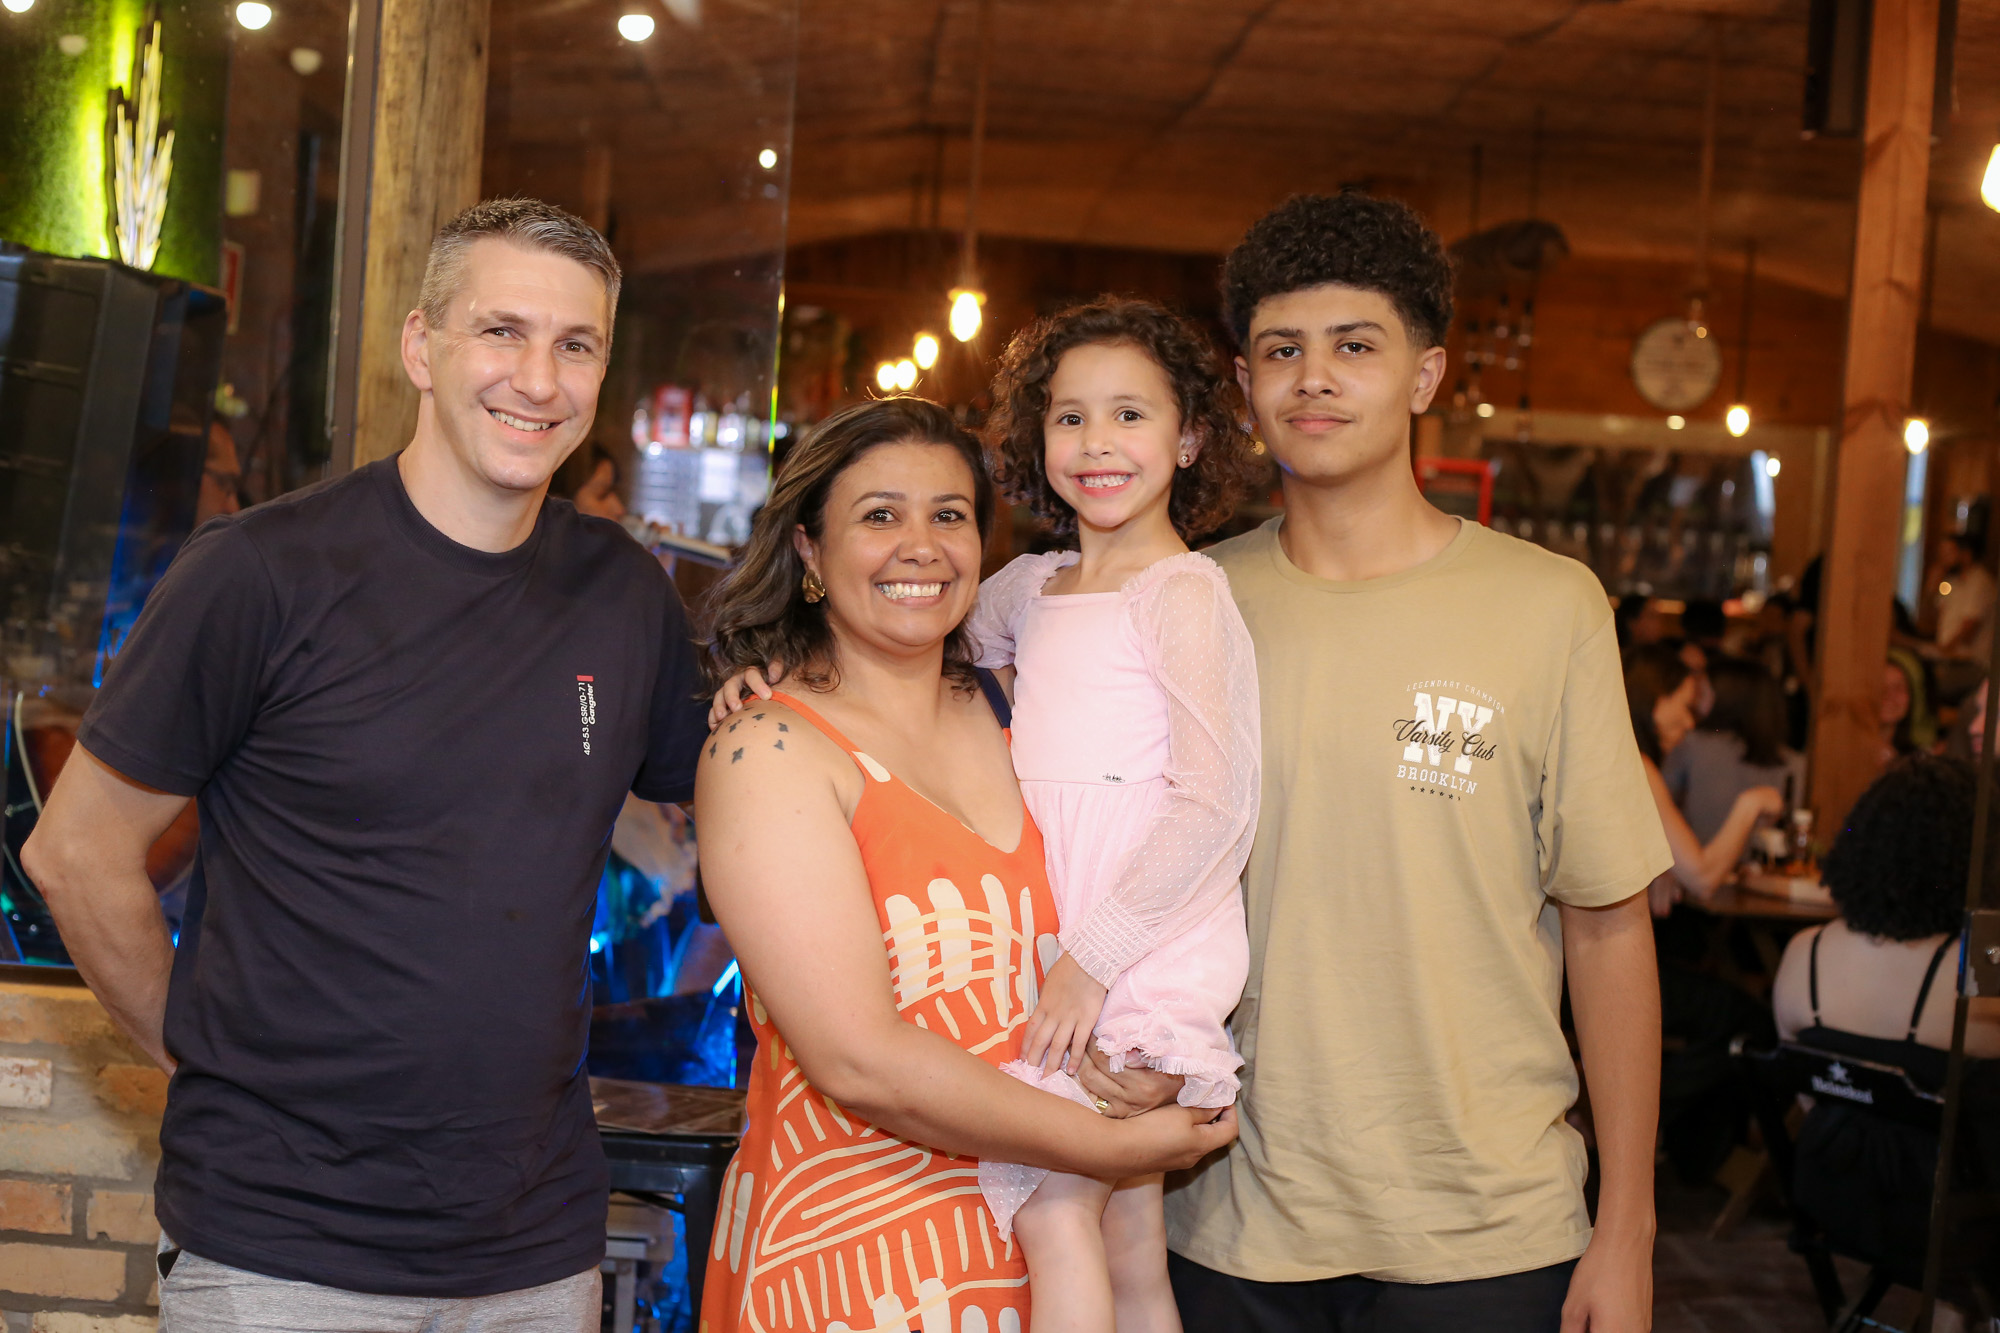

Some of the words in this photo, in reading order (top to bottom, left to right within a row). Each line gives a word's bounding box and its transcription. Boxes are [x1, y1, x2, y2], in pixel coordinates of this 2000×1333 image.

[1406, 679, 1461, 692] LEGENDARY
[587, 683, 597, 725] Gangster
[1392, 719, 1455, 753] Varsity
[1461, 731, 1498, 761] Club
[1403, 692, 1494, 775] NY
[1396, 765, 1478, 795] BROOKLYN
[1811, 1075, 1874, 1104] Heineken
